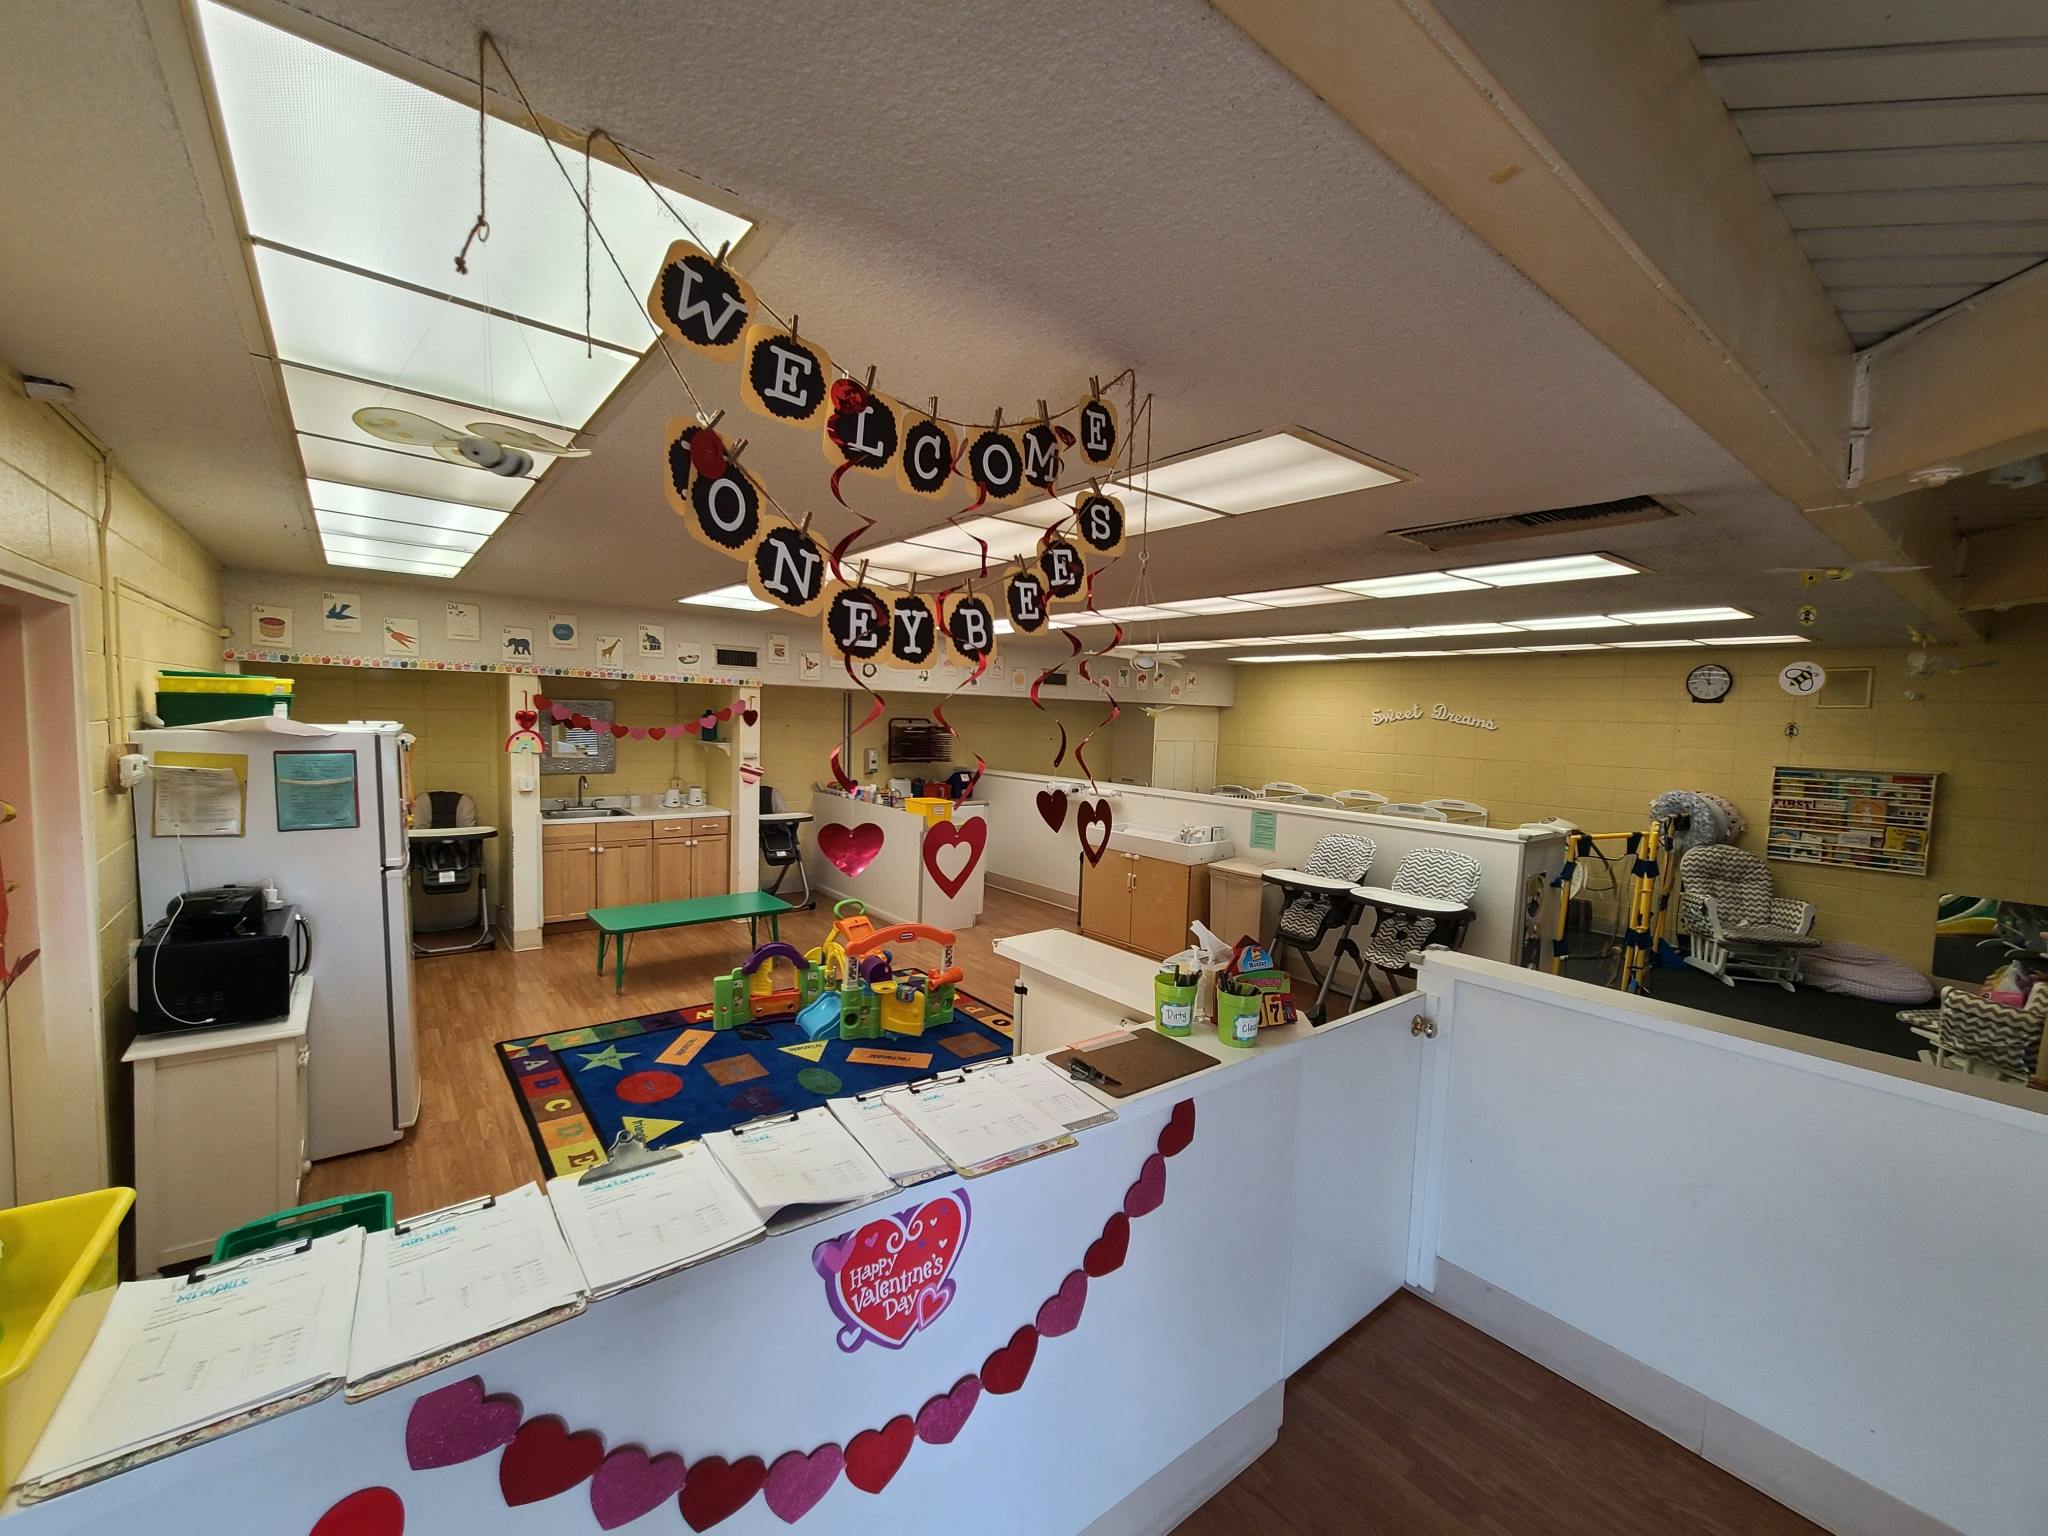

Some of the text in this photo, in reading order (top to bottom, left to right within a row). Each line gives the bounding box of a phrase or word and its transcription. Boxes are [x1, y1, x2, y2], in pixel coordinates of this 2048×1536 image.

[677, 260, 1107, 485] WELCOME
[1372, 703, 1498, 730] Sweet Dreams
[1165, 1009, 1187, 1021] Dirty
[524, 1059, 549, 1071] A
[544, 1099, 572, 1112] C
[567, 1149, 600, 1168] E
[849, 1253, 898, 1290] Happy
[852, 1253, 943, 1313] Valentine's
[882, 1289, 919, 1321] Day
